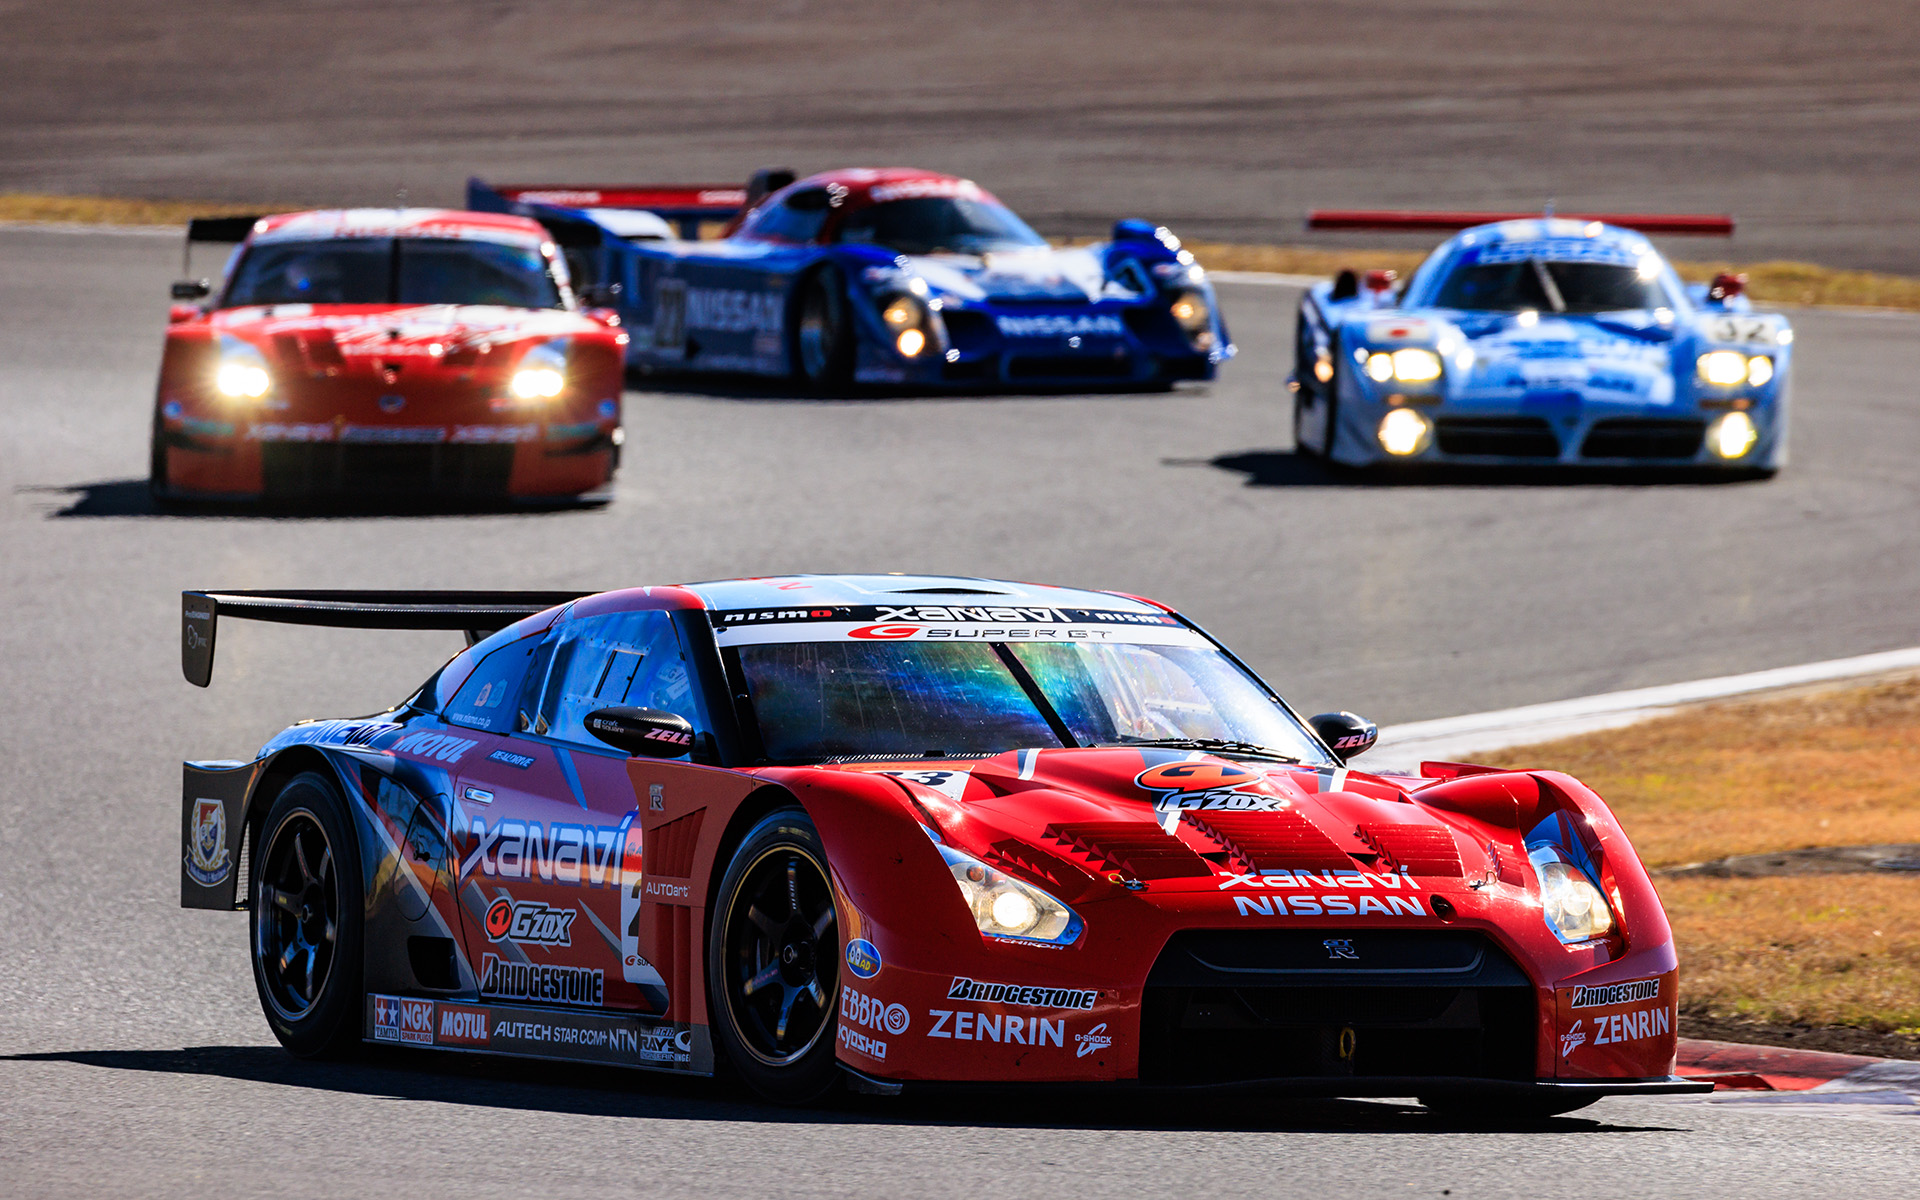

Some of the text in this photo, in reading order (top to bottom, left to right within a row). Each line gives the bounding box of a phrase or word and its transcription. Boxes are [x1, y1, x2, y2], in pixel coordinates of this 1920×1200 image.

[686, 288, 784, 332] NISSAN
[723, 609, 833, 622] nismo
[1094, 612, 1178, 625] nismo
[926, 629, 1057, 638] SUPER
[1067, 629, 1113, 639] GT
[452, 712, 492, 728] www.nismo.co.jp
[602, 724, 625, 734] square
[644, 727, 692, 746] ZELE
[1333, 730, 1375, 750] ZELE
[390, 731, 479, 764] MOTUL
[490, 750, 536, 768] REALDRIVE
[646, 882, 689, 898] AUTOart
[1232, 895, 1427, 917] NISSAN
[994, 937, 1065, 951] ICHIKOH
[481, 952, 604, 1007] BRIDGESTONE
[947, 976, 1098, 1011] BRIDGESTONE
[1571, 978, 1660, 1009] BRIDGESTONE
[401, 1003, 433, 1032] NGK
[841, 985, 911, 1036] EBBRO
[375, 1026, 399, 1039] TAMIYA
[440, 1011, 488, 1040] MOTUL
[493, 1021, 551, 1041] AUTECH
[553, 1027, 578, 1044] STAR
[926, 1009, 1065, 1048] ZENRIN
[1593, 1006, 1670, 1045] ZENRIN
[401, 1031, 432, 1043] SPARK PLUGS
[609, 1028, 638, 1053] NTN
[838, 1023, 887, 1059] KYOSHO
[1074, 1033, 1112, 1044] G-SHOCK
[1560, 1032, 1587, 1042] G-SHOCK
